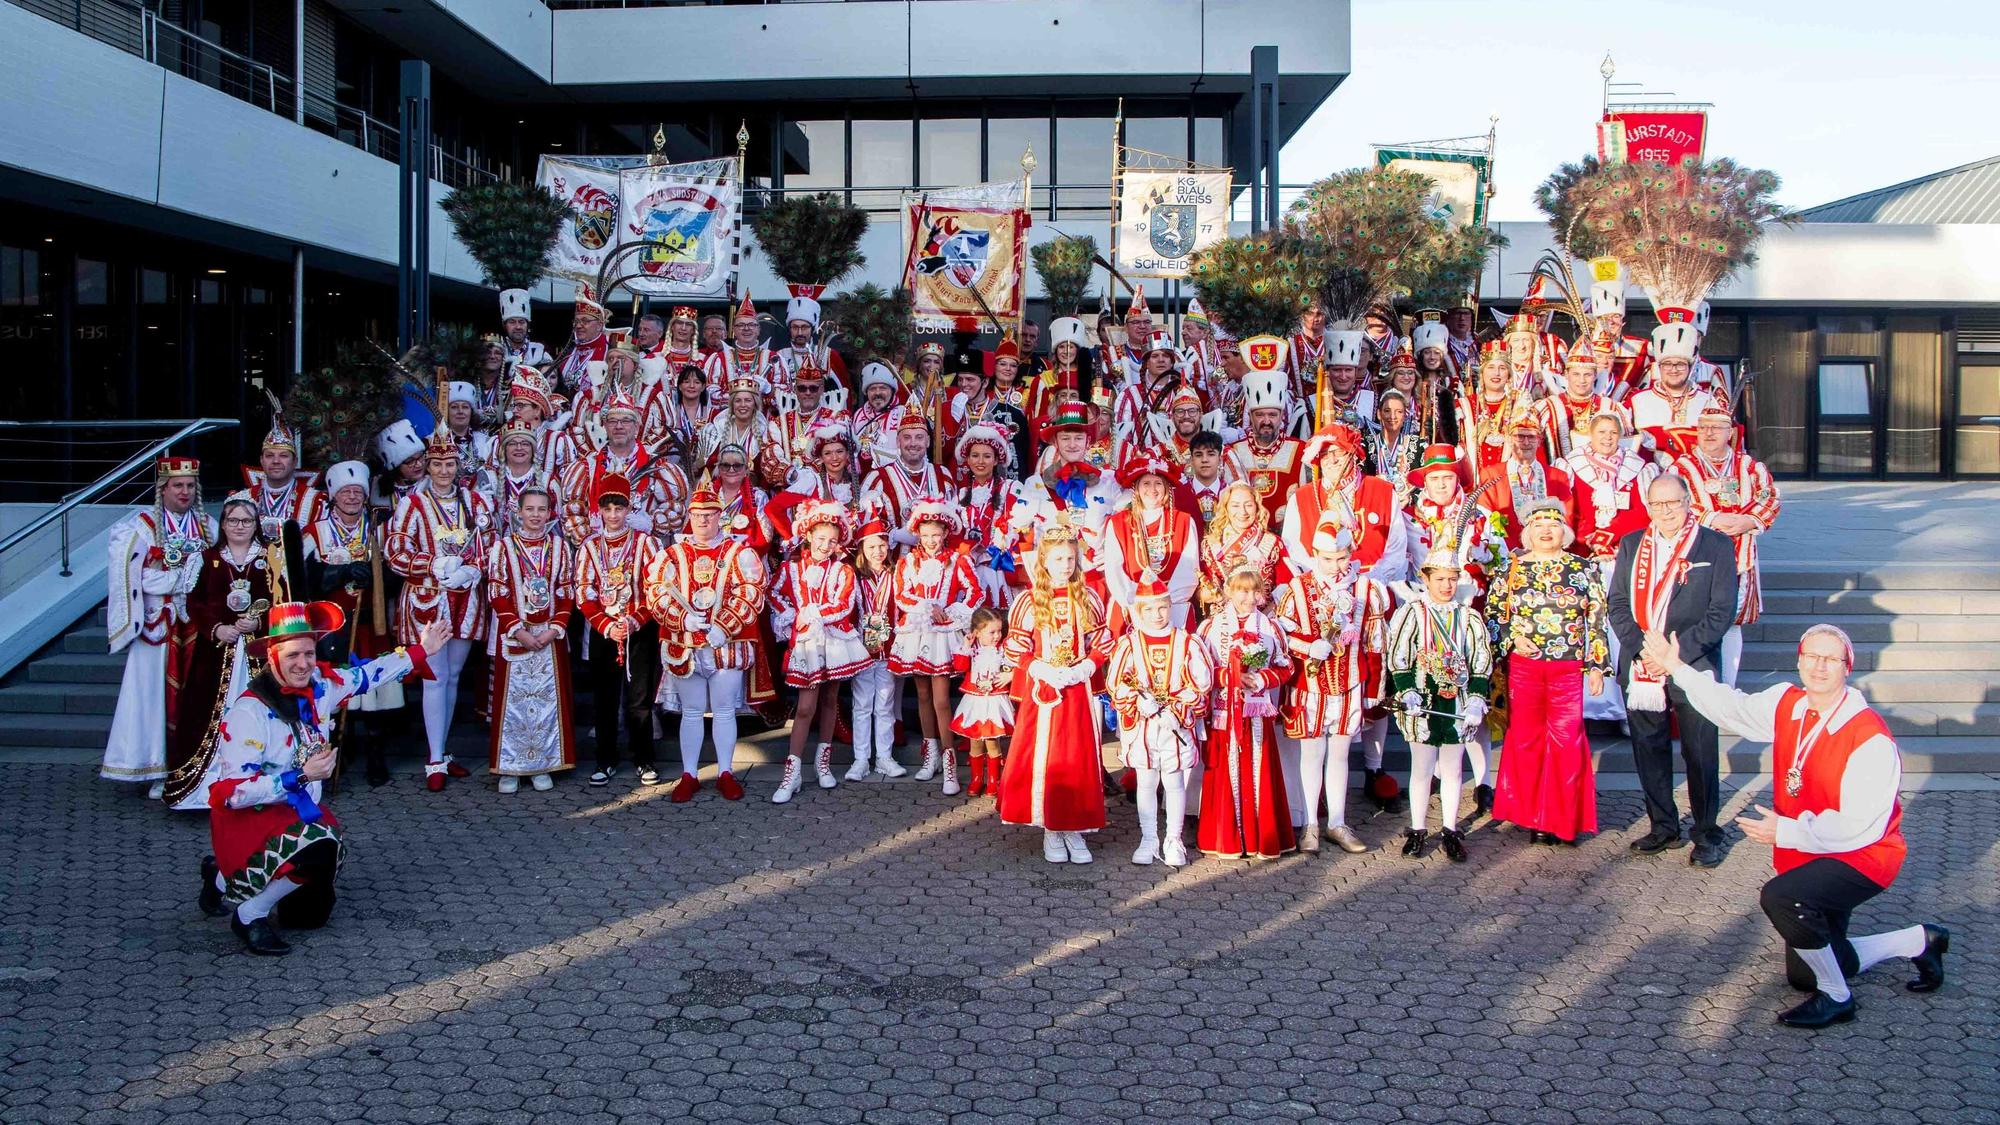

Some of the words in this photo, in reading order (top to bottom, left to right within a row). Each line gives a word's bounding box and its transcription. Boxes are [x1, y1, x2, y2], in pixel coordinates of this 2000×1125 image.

[1636, 148, 1671, 163] 1955
[1177, 186, 1205, 195] BLAU
[1176, 195, 1213, 204] WEISS
[1134, 223, 1147, 233] 19
[1200, 224, 1213, 234] 77
[1134, 259, 1189, 270] SCHLEID
